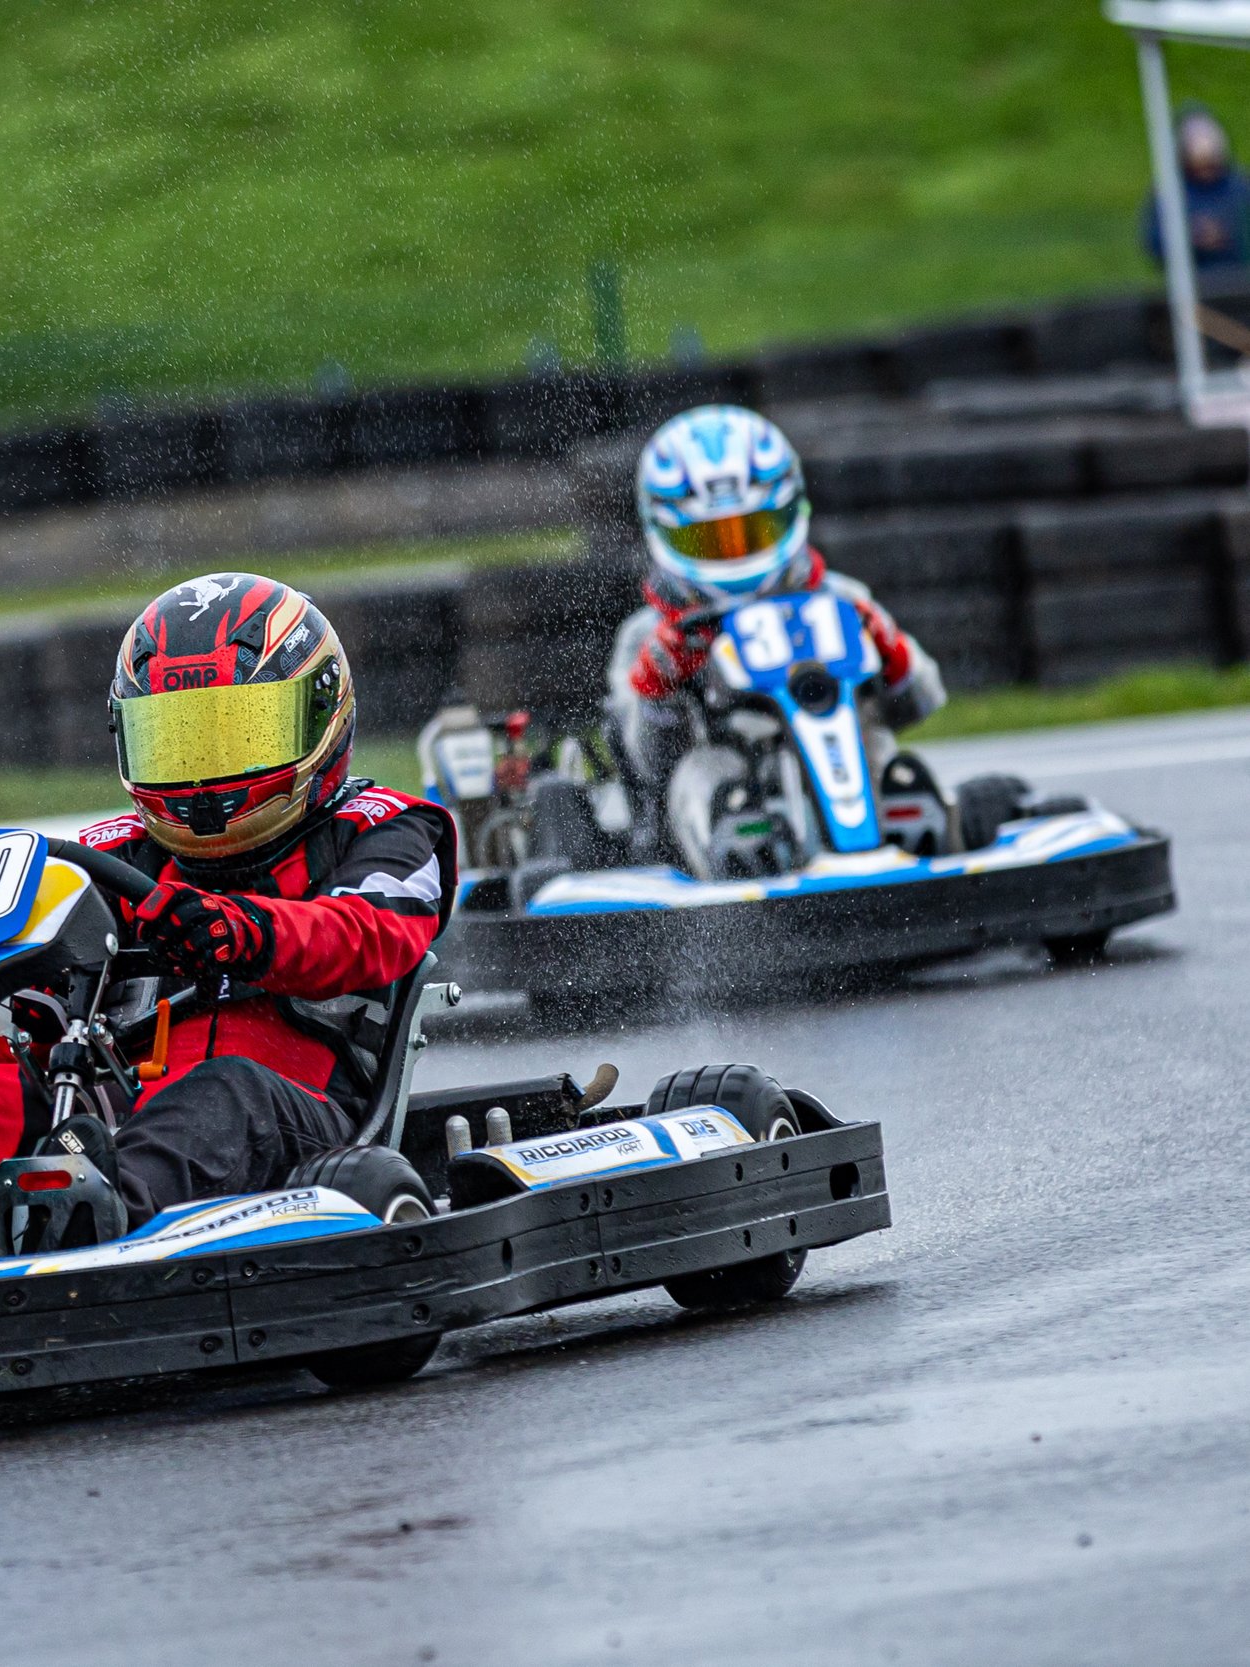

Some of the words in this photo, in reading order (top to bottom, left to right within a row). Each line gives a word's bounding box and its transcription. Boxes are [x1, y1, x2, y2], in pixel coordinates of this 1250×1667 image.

[734, 593, 847, 671] 31
[163, 668, 218, 691] OMP
[342, 801, 386, 818] OMP
[678, 1119, 720, 1138] DRS
[60, 1132, 82, 1153] OMP
[518, 1127, 637, 1164] RICCIARDO
[616, 1139, 645, 1156] KART
[271, 1200, 319, 1217] KART
